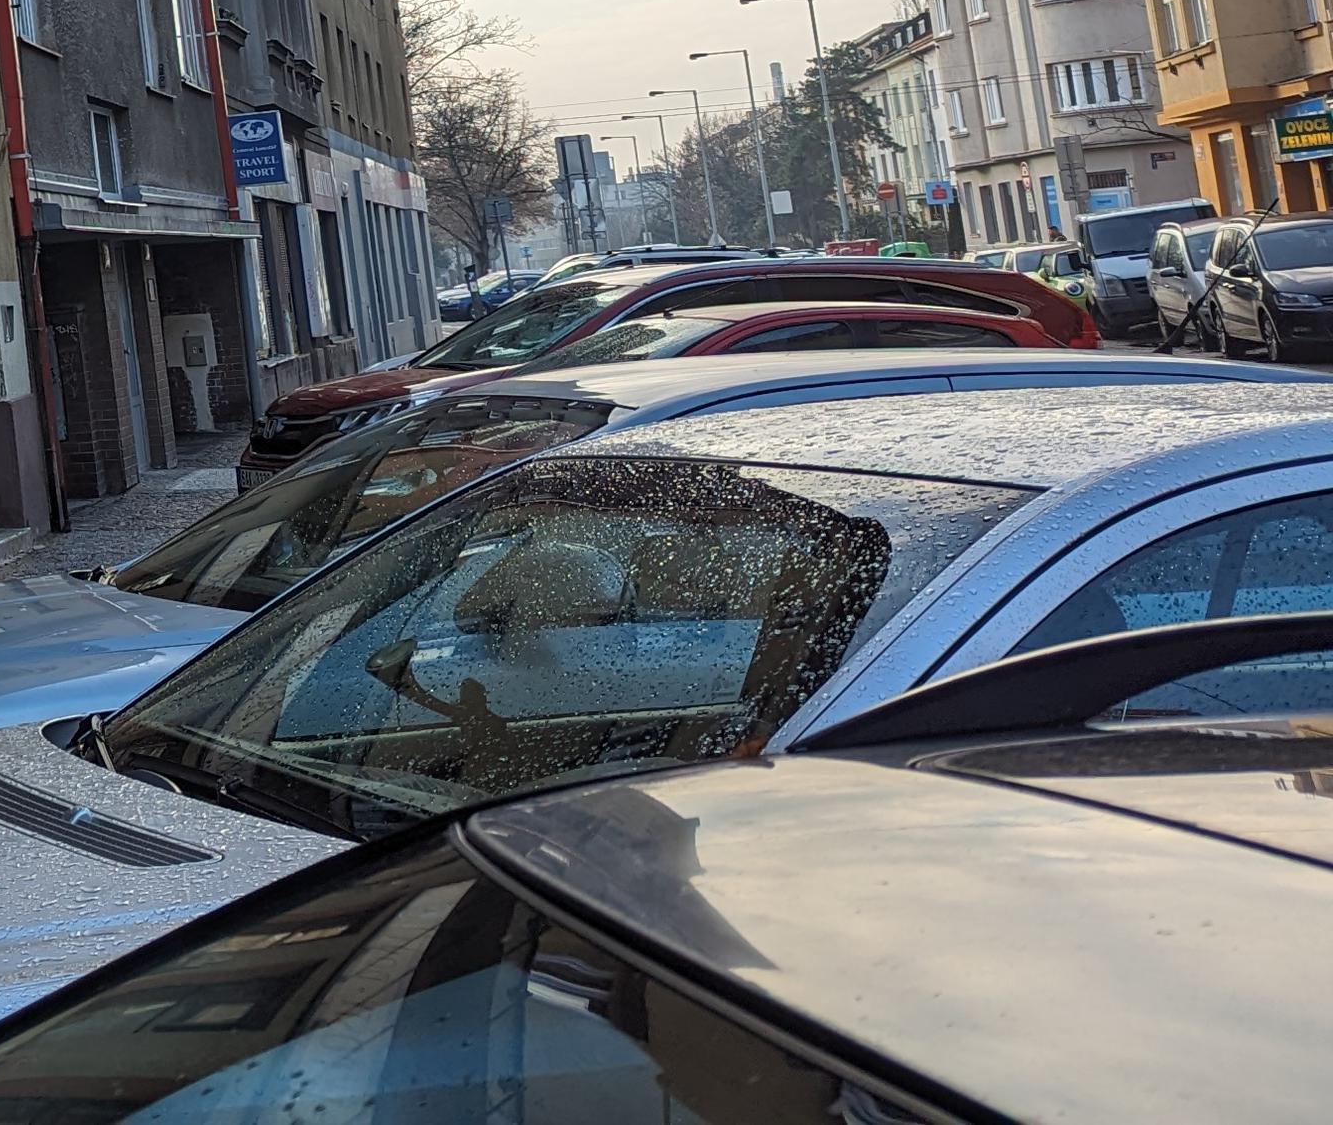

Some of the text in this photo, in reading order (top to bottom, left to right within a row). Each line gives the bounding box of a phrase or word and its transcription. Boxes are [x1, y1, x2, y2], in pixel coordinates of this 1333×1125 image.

[1285, 118, 1329, 134] OVOCE
[1280, 132, 1333, 149] ZELENIN
[235, 155, 279, 168] TRAVEL
[239, 167, 276, 179] SPORT
